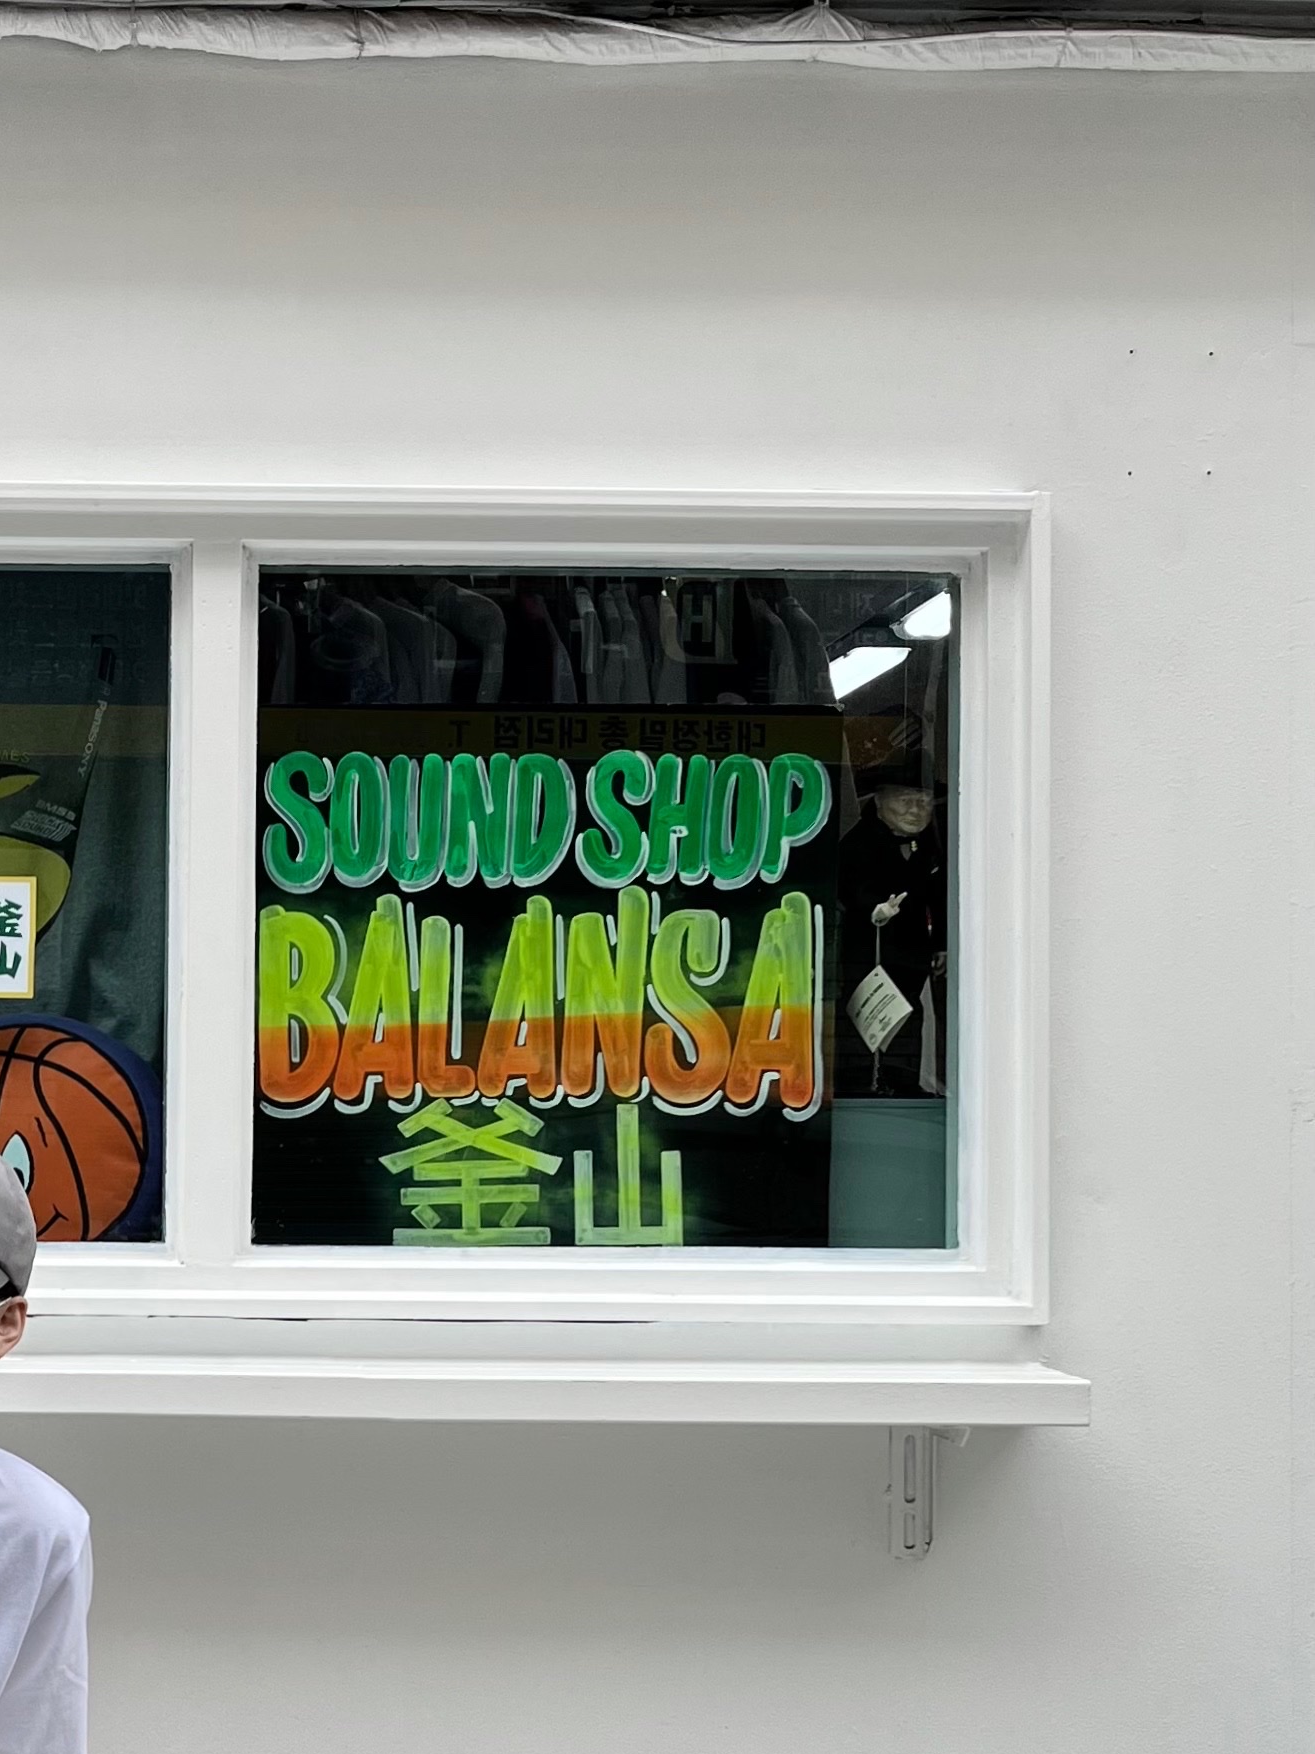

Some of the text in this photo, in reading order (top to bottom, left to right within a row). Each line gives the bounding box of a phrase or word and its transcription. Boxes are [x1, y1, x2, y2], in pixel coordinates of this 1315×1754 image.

[263, 749, 832, 894] SOUND SHOP
[257, 885, 824, 1123] BALANSA
[379, 1097, 684, 1248] 釜山
